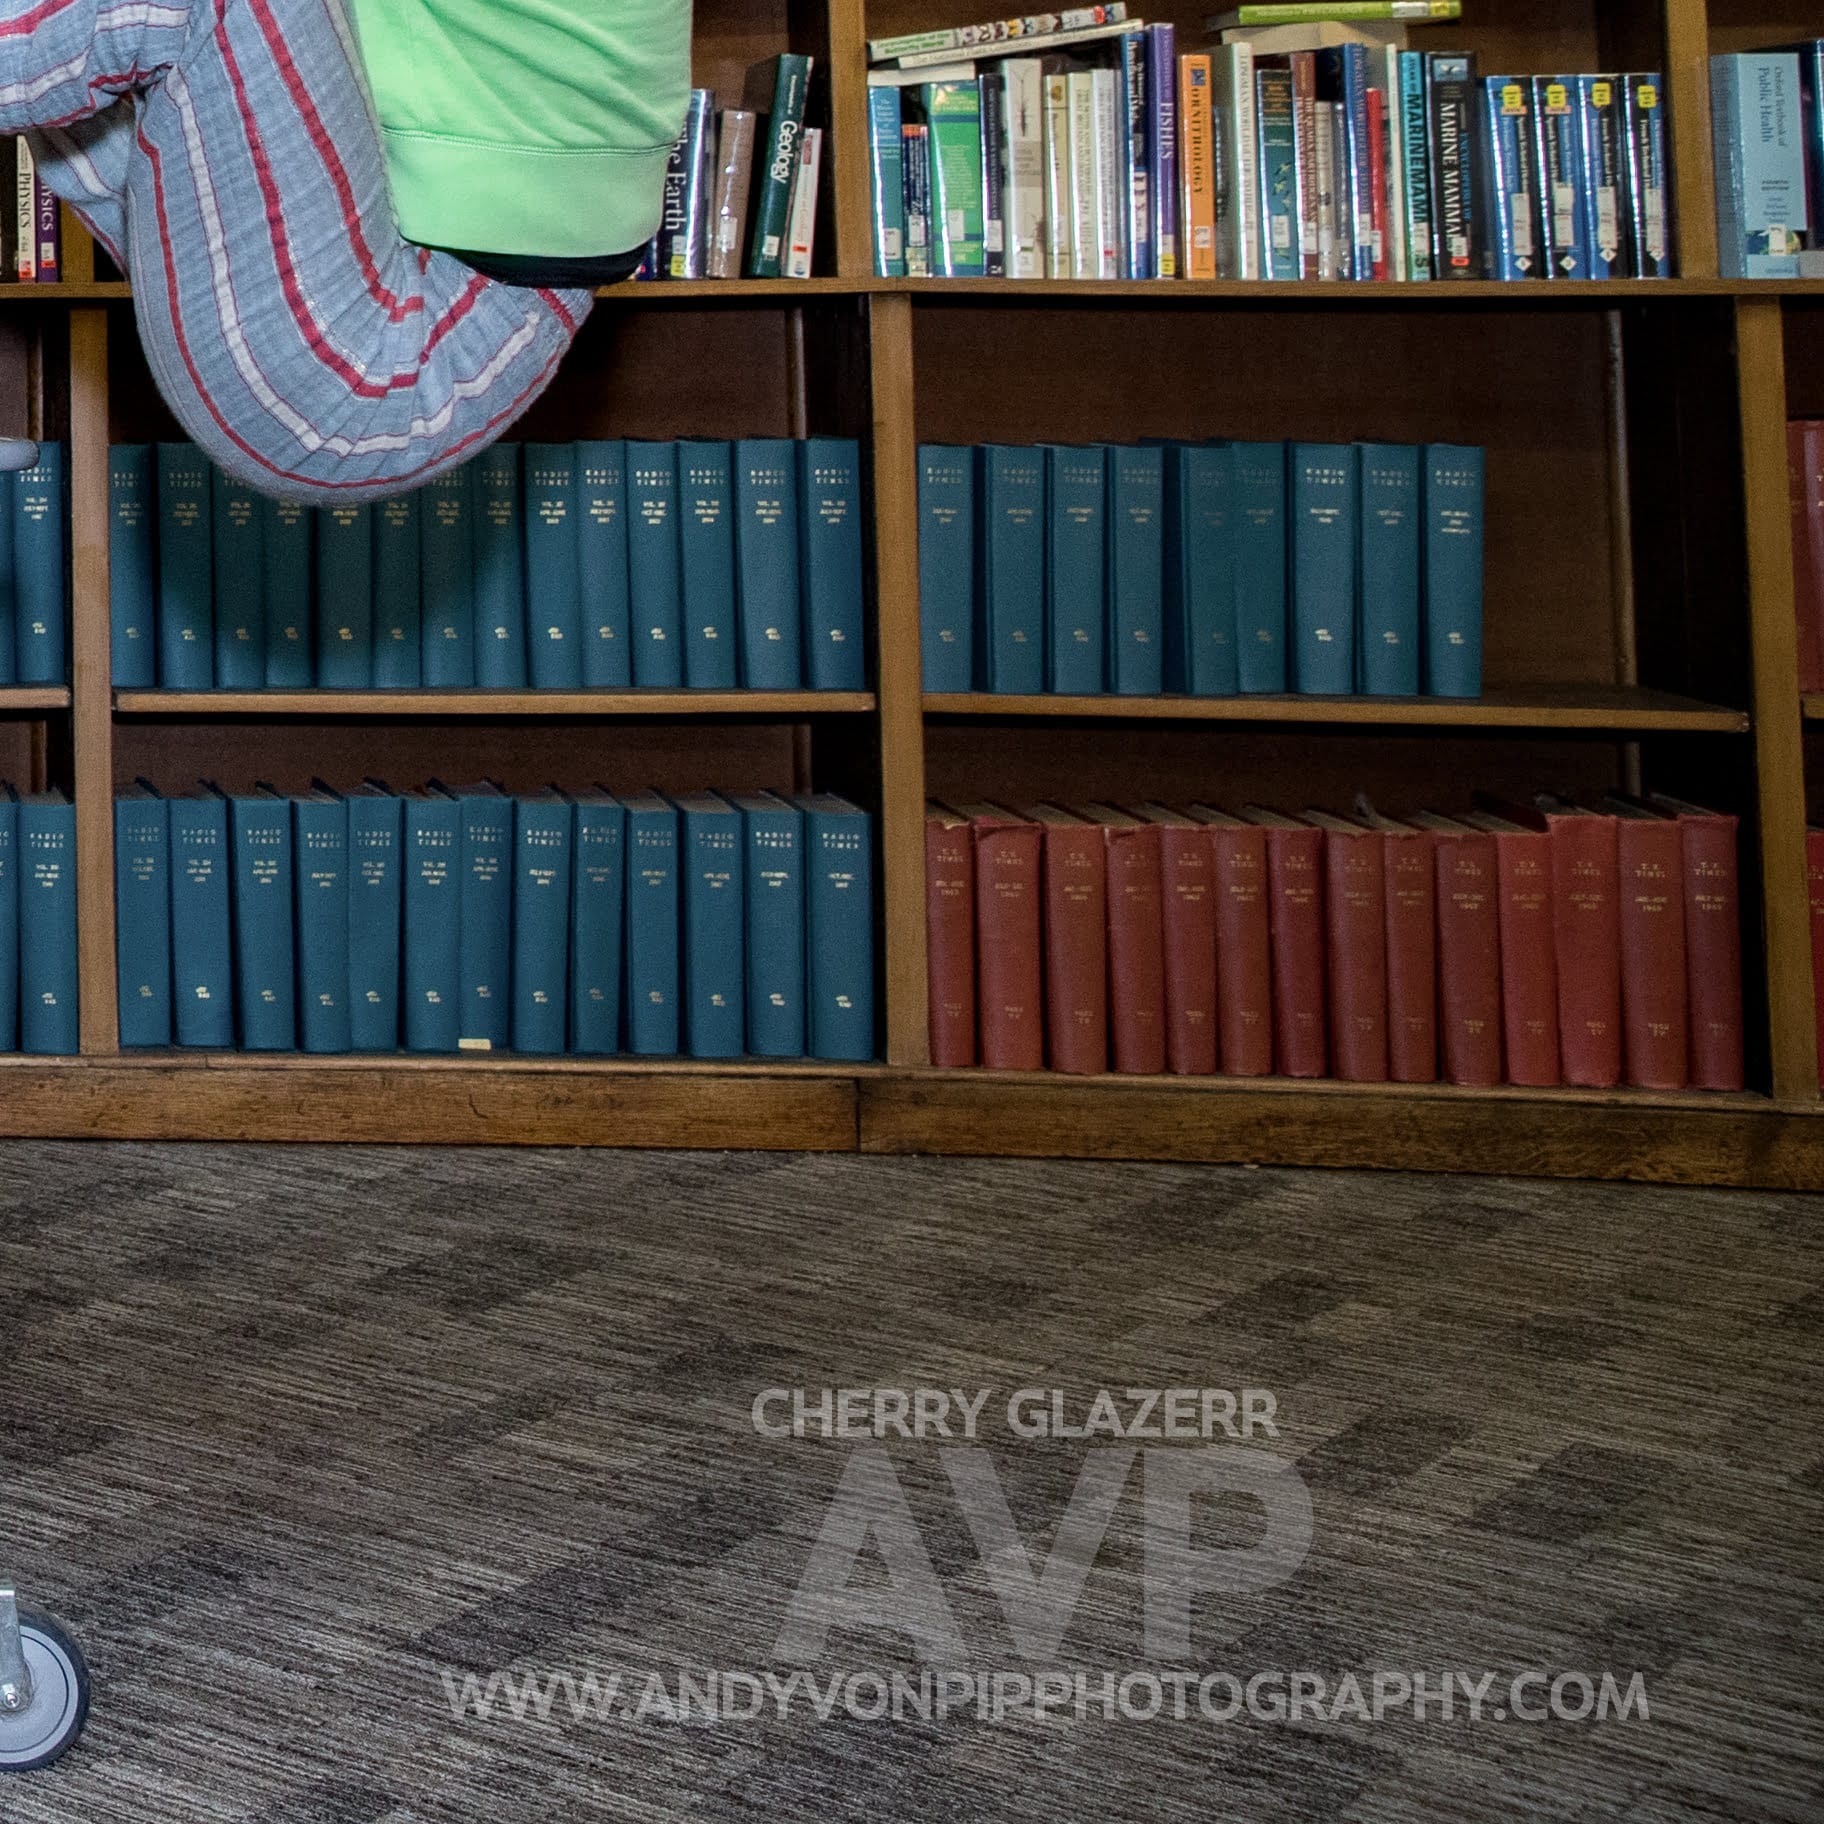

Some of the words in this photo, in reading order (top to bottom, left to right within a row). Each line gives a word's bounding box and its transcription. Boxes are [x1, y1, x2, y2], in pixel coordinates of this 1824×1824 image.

[1757, 67, 1771, 102] Public
[1774, 66, 1785, 97] Oxford
[1160, 102, 1175, 159] FISHES
[1407, 93, 1425, 168] MARINE
[1441, 103, 1458, 165] MARINE
[1760, 106, 1775, 143] Health
[1776, 98, 1787, 135] Textbook
[771, 120, 798, 183] Geology
[1191, 88, 1205, 194] ORNITHOLOGY
[1777, 137, 1787, 147] of
[20, 172, 33, 228] PHYSICS
[665, 172, 688, 230] Earth
[755, 831, 793, 839] RADIO
[756, 840, 793, 849] TIMES
[822, 832, 860, 841] RADIO
[824, 841, 859, 849] TIMES
